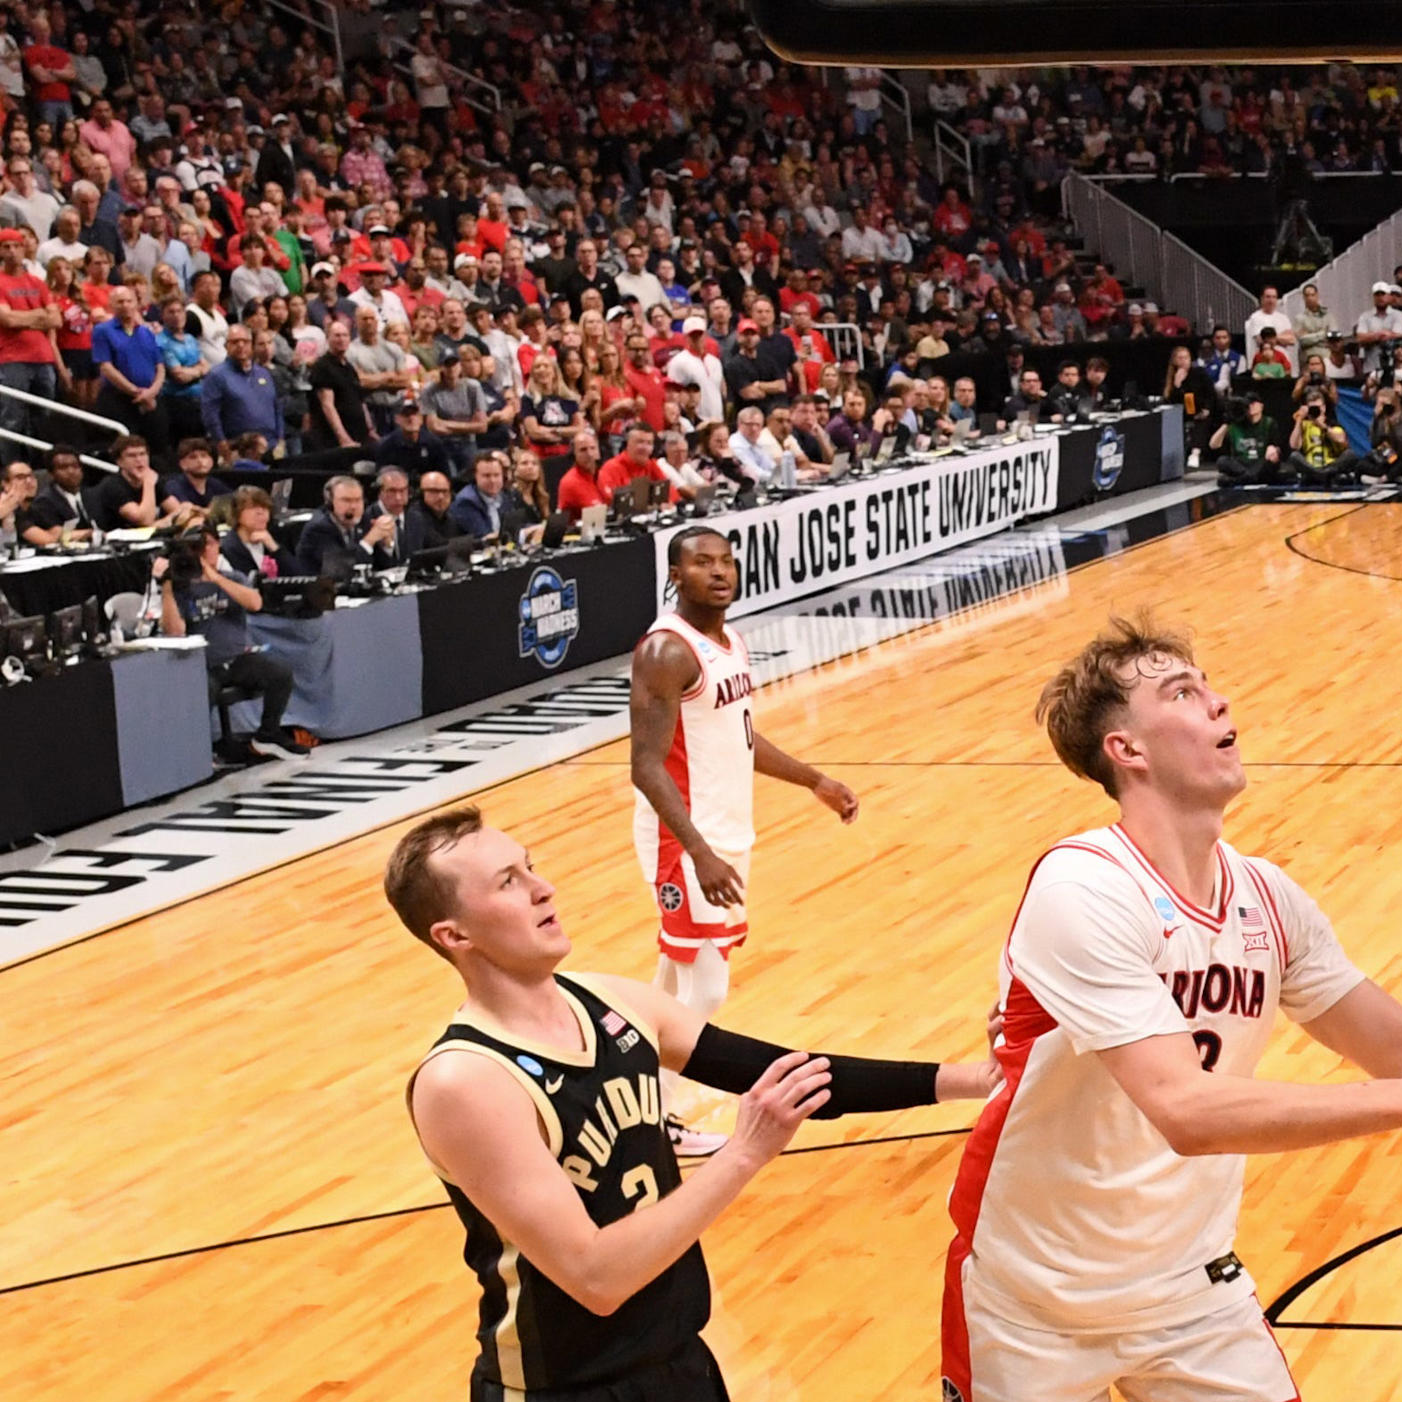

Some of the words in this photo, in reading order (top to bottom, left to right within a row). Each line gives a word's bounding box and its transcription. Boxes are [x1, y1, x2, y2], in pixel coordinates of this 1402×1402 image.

[727, 519, 780, 602] SAN
[790, 499, 856, 584] JOSE
[866, 479, 931, 561] STATE
[938, 448, 1051, 538] UNIVERSITY
[744, 708, 754, 751] 0
[112, 756, 482, 836] FINAL
[1157, 963, 1265, 1019] RIONA
[562, 1073, 665, 1192] PUDU
